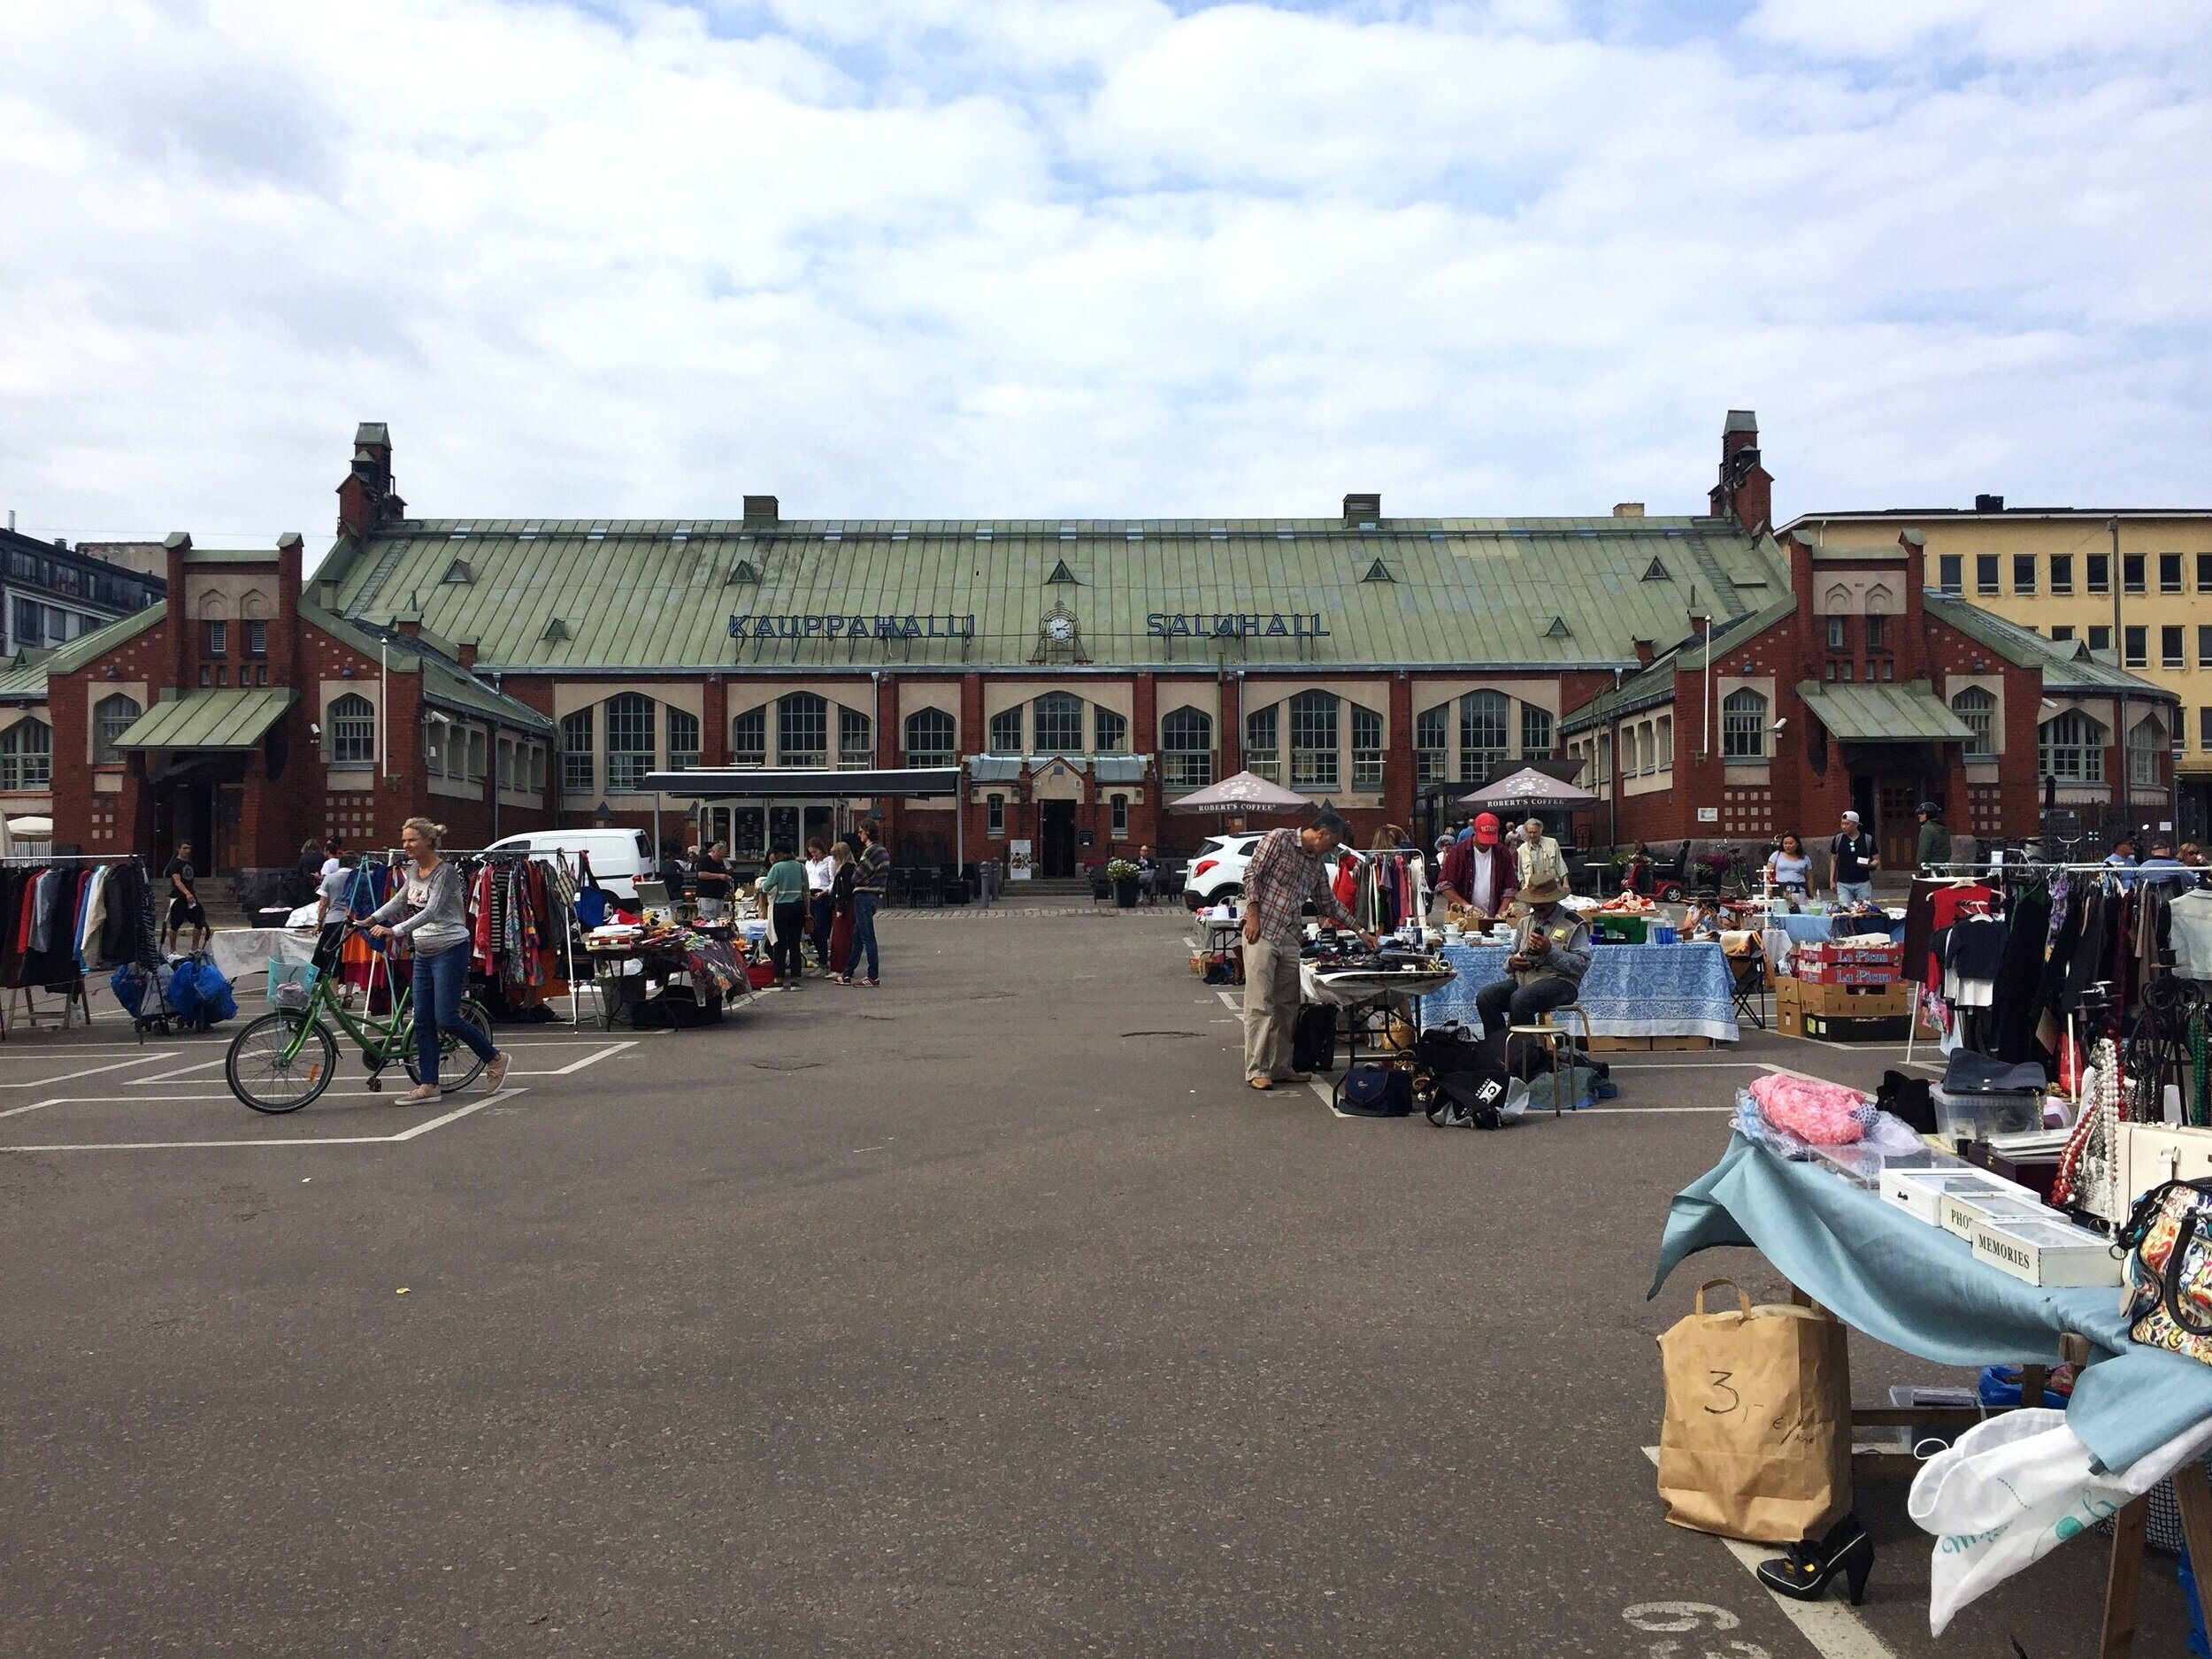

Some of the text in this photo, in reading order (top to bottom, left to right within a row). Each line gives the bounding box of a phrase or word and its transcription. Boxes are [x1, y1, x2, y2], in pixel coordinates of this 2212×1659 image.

[729, 614, 975, 638] KAUPPAHALLI
[1147, 613, 1331, 636] SALUHALL
[1198, 803, 1238, 812] ROBERT'S
[1486, 798, 1528, 808] ROBERT'S
[1837, 950, 1854, 963] La
[1836, 969, 1854, 983] La
[1978, 1233, 2030, 1270] MEMORIES
